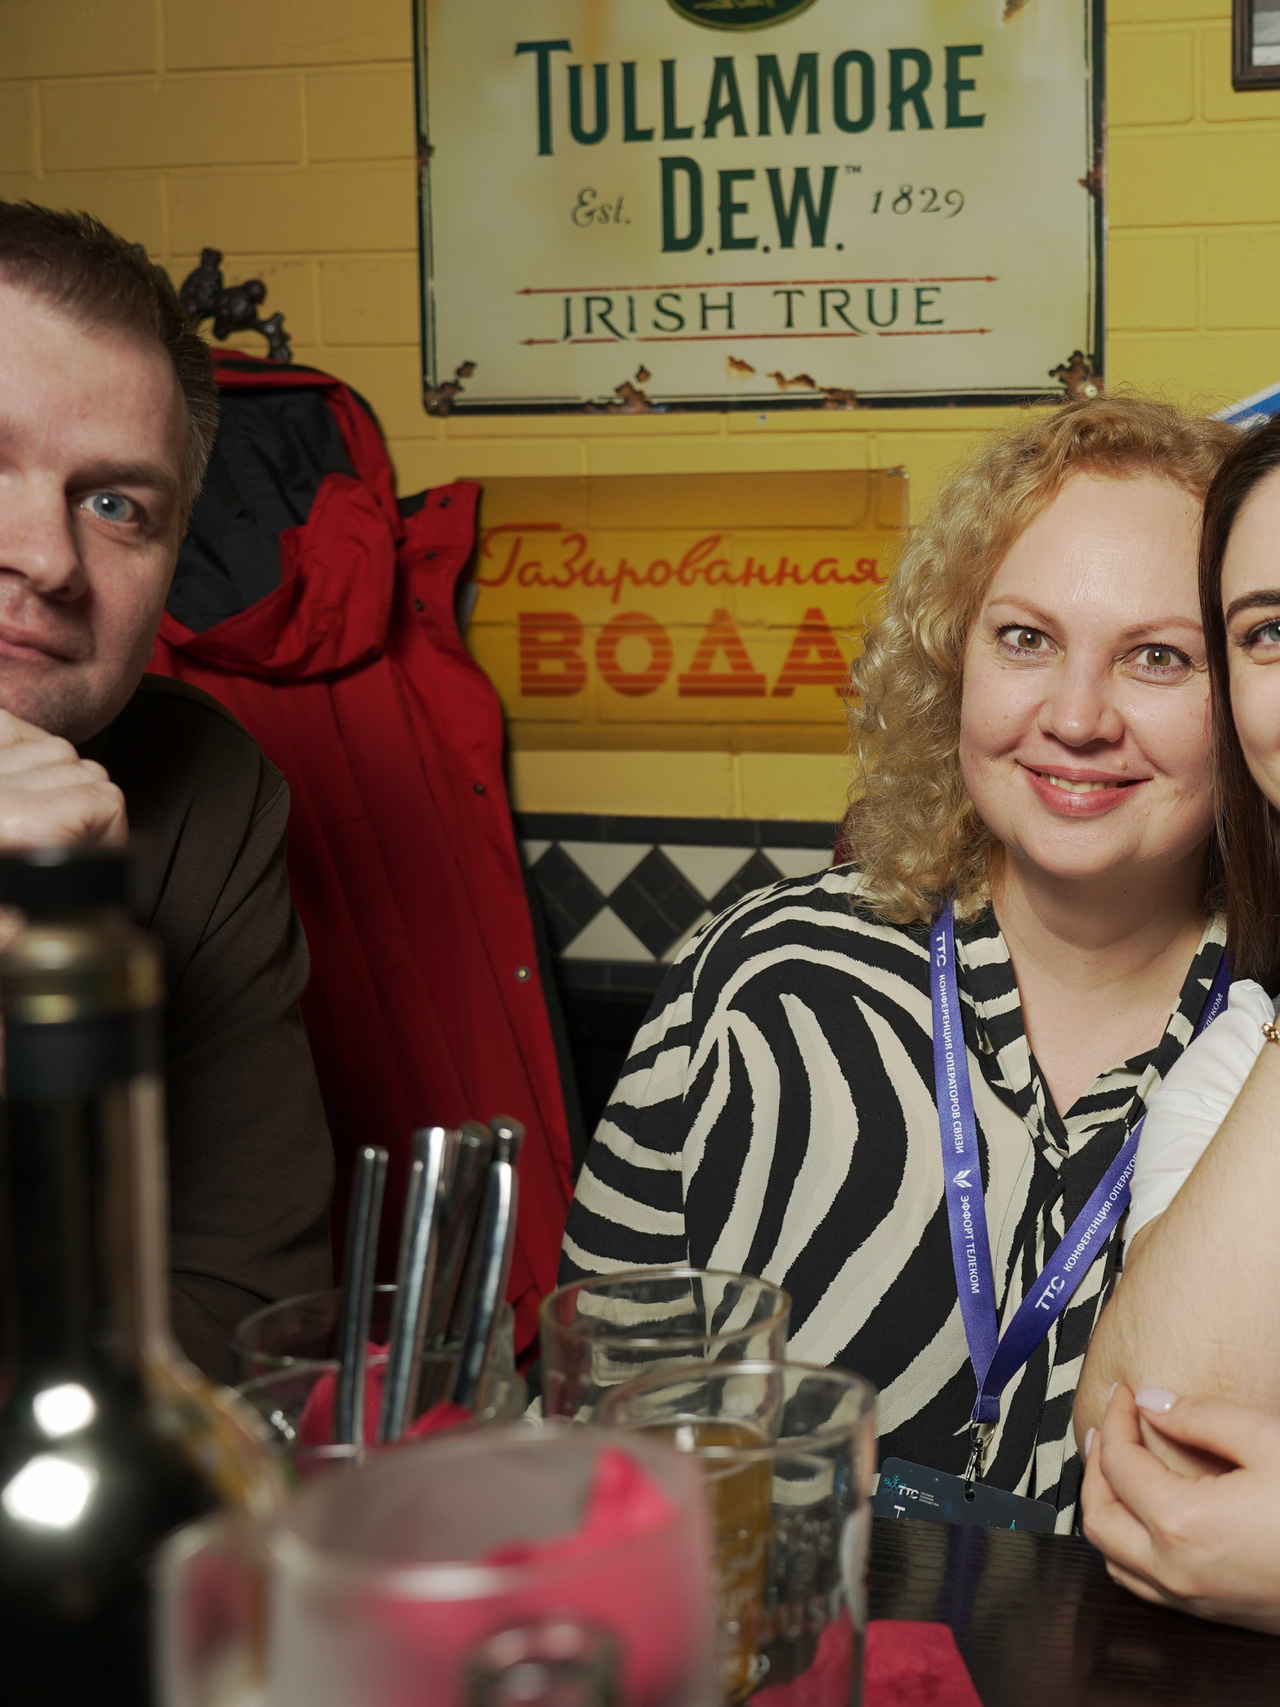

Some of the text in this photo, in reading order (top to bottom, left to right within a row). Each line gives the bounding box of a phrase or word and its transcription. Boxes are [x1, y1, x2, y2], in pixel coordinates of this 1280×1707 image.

[514, 39, 986, 156] TULLAMORE
[571, 185, 964, 227] Est. 1829
[562, 287, 945, 342] IRISH TRUE
[477, 523, 887, 603] Газированная
[518, 608, 864, 697] ВОДА
[939, 974, 951, 1050] КОНФЕРЕНЦИЯ
[946, 1051, 961, 1119] ОПЕРАТОРОВ
[952, 1120, 964, 1154] СВЯЗИ
[960, 1195, 981, 1294] ЭФФОРТ ТЕЛЕКОМ
[1063, 1200, 1113, 1272] КОНФЕРЕНЦИЯ
